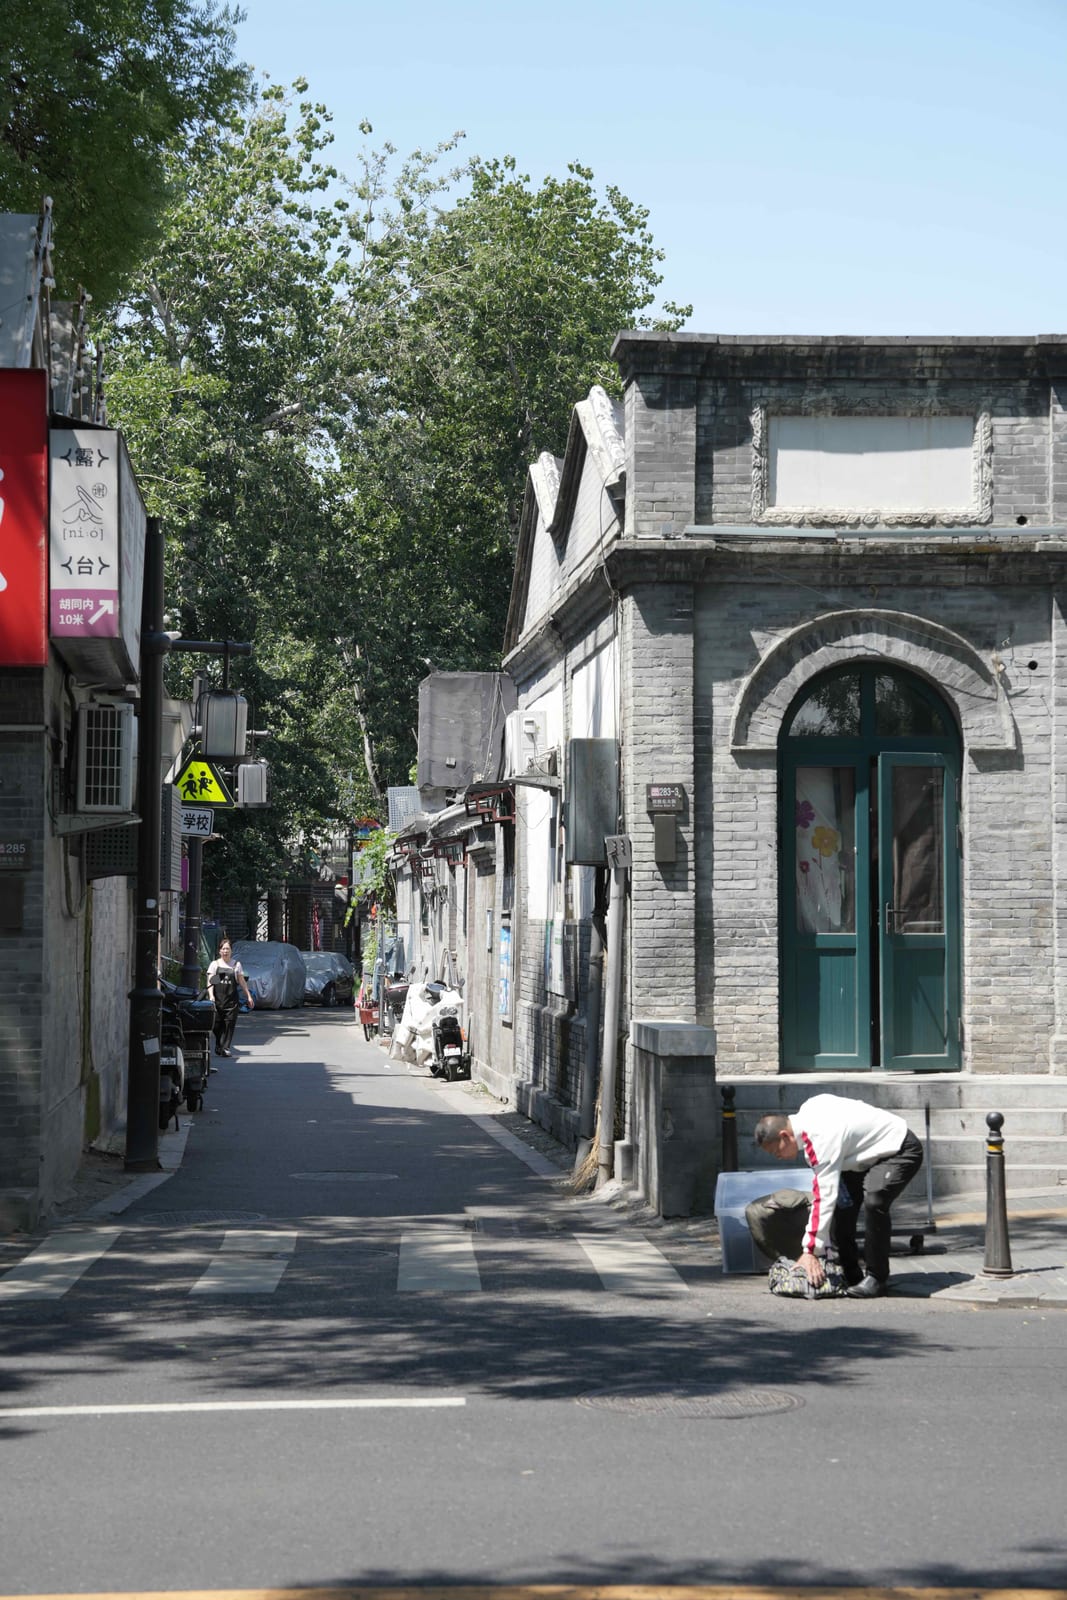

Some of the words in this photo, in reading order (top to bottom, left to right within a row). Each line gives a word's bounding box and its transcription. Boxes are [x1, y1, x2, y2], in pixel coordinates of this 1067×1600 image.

[77, 555, 94, 575] 台
[59, 598, 94, 610] 胡同内
[59, 614, 84, 625] 10米
[181, 813, 209, 831] 学校
[6, 843, 26, 854] 285
